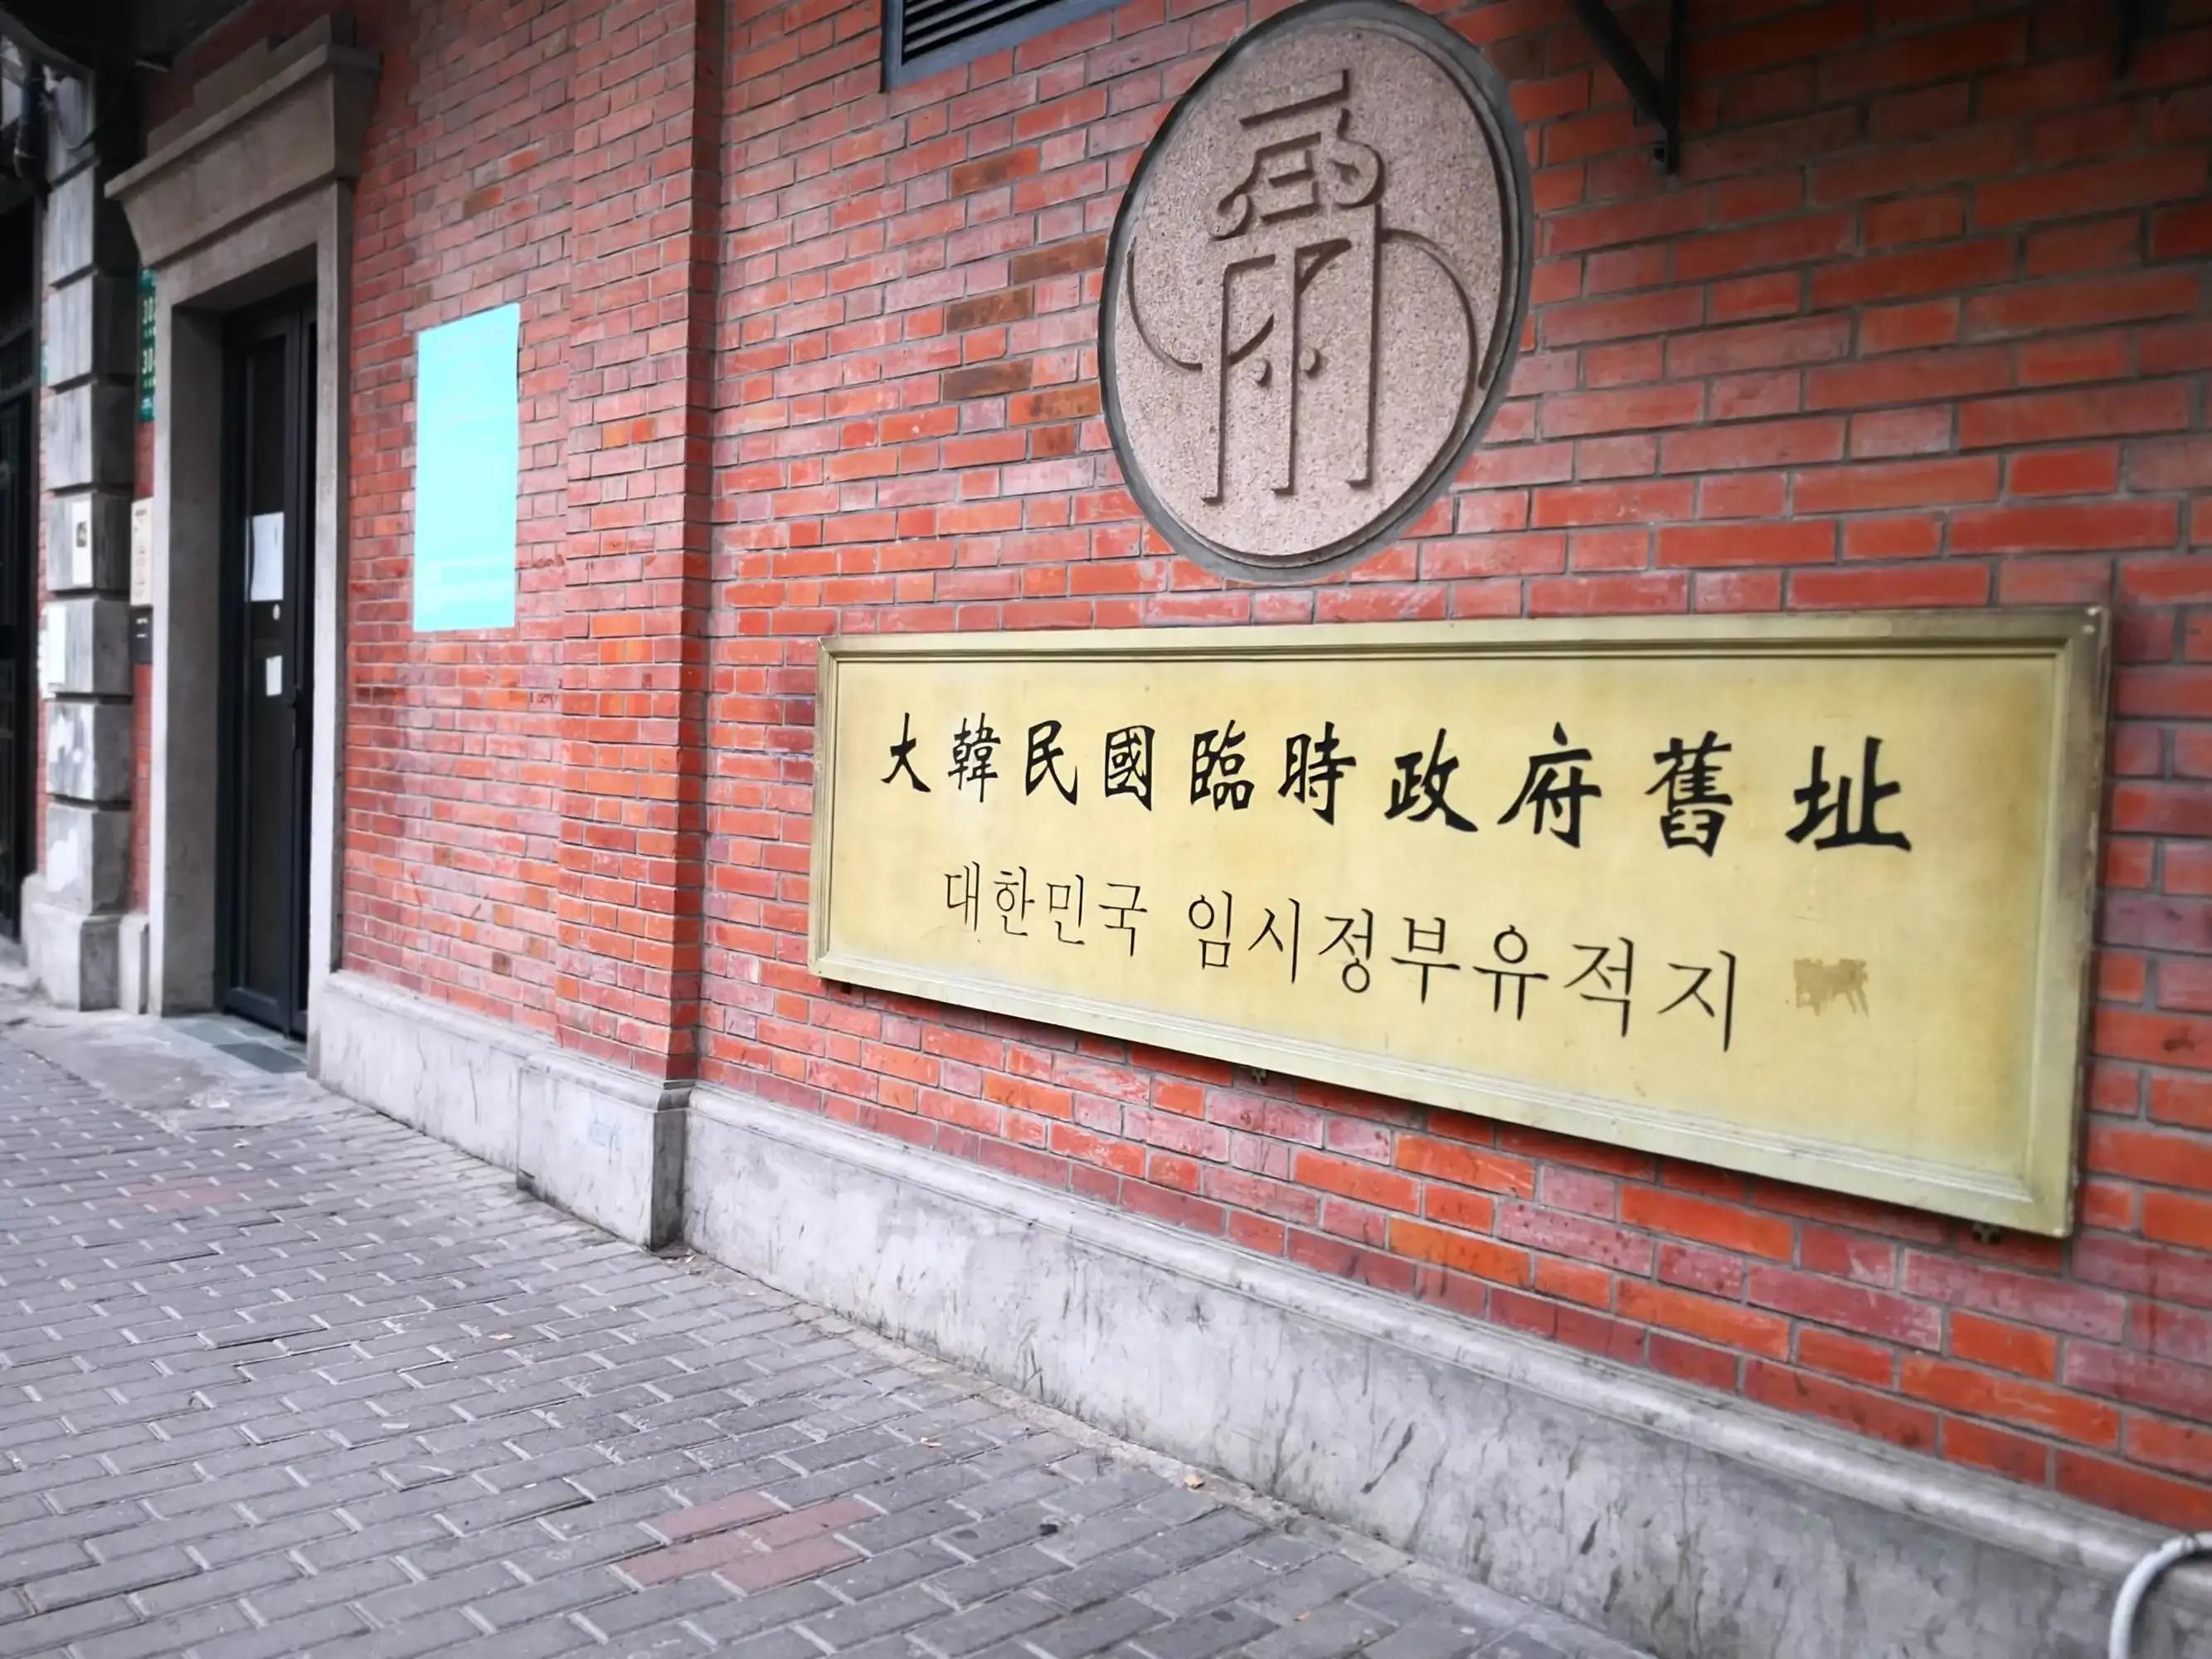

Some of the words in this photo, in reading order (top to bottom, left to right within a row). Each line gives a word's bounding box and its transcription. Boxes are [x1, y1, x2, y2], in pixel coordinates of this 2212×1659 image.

[881, 712, 1912, 857] 大韓民國臨時政府舊址
[944, 860, 1148, 957] 대한민국
